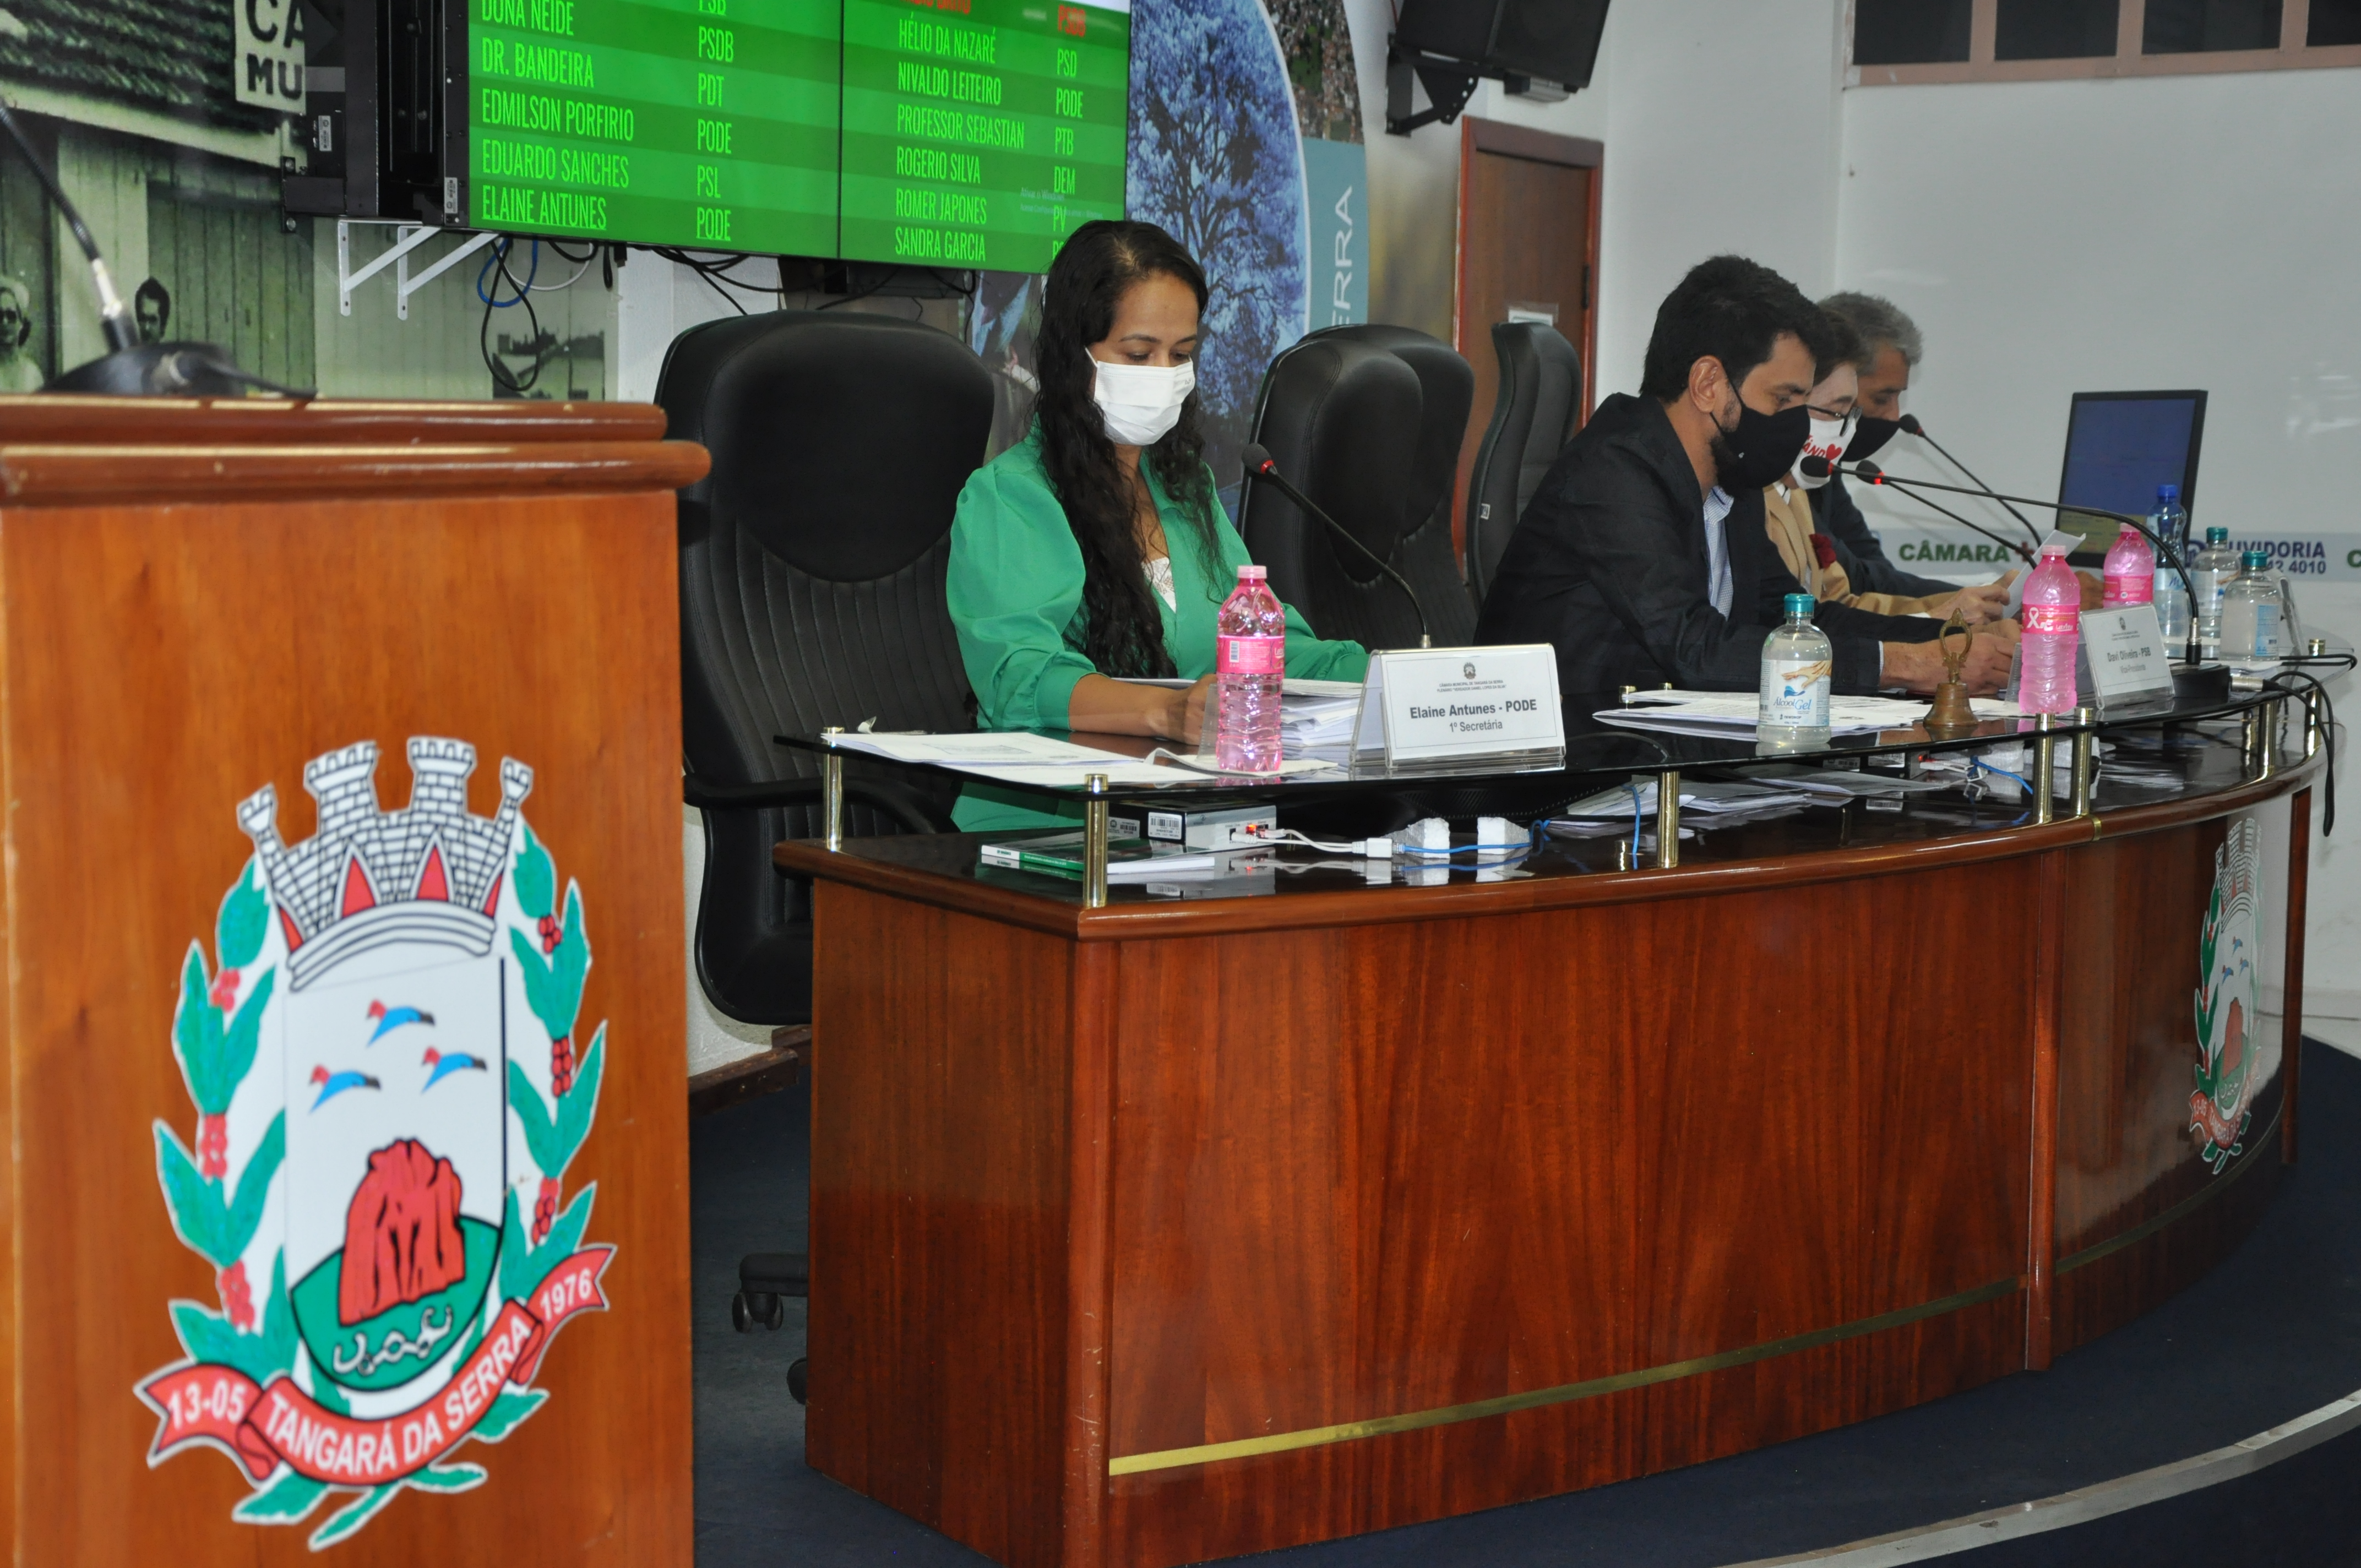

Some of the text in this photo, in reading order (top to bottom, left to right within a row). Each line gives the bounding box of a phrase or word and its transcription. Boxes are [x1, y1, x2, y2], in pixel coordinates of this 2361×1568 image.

[482, 0, 574, 36] DONA NEIDE
[699, 25, 734, 63] PSDB
[899, 11, 996, 64] HÉLIO DA NAZARÉ
[482, 37, 594, 88] DR. BANDEIRA
[1057, 47, 1077, 78] PSD
[698, 72, 724, 107] PDT
[898, 61, 1002, 106] NIVALDO LEITEIRO
[482, 88, 634, 141] EDMILSON PORFIRIO
[1056, 87, 1084, 118] PODE
[697, 118, 732, 154] PODE
[897, 103, 1025, 149] PROFESSOR SEBASTIAN
[1055, 126, 1074, 155] PTB
[482, 139, 629, 188] EDUARDO SANCHES
[697, 165, 721, 198] PSL
[896, 145, 981, 184] ROGERIO SILVA
[1054, 166, 1075, 195] DEM
[482, 184, 534, 224] ELAINE
[539, 191, 607, 230] ANTUNES
[696, 206, 731, 241] PODE
[896, 187, 936, 220] ROMER
[939, 192, 987, 225] JAPONES
[1053, 205, 1067, 232] PV
[895, 226, 986, 262] SANDRA GARCIA
[1900, 539, 2010, 562] CÂMARA
[2229, 541, 2326, 558] UVIDORIA
[2289, 560, 2327, 574] 4010
[1410, 706, 1446, 719] Elaine
[1449, 704, 1496, 716] Antunes
[1505, 699, 1537, 712] PODE
[1795, 699, 1813, 710] Gel
[1460, 719, 1503, 732] Secretária
[540, 1268, 592, 1322] 1976
[167, 1378, 246, 1430] 13-05
[265, 1315, 531, 1476] TANGARÁ DA SERRA
